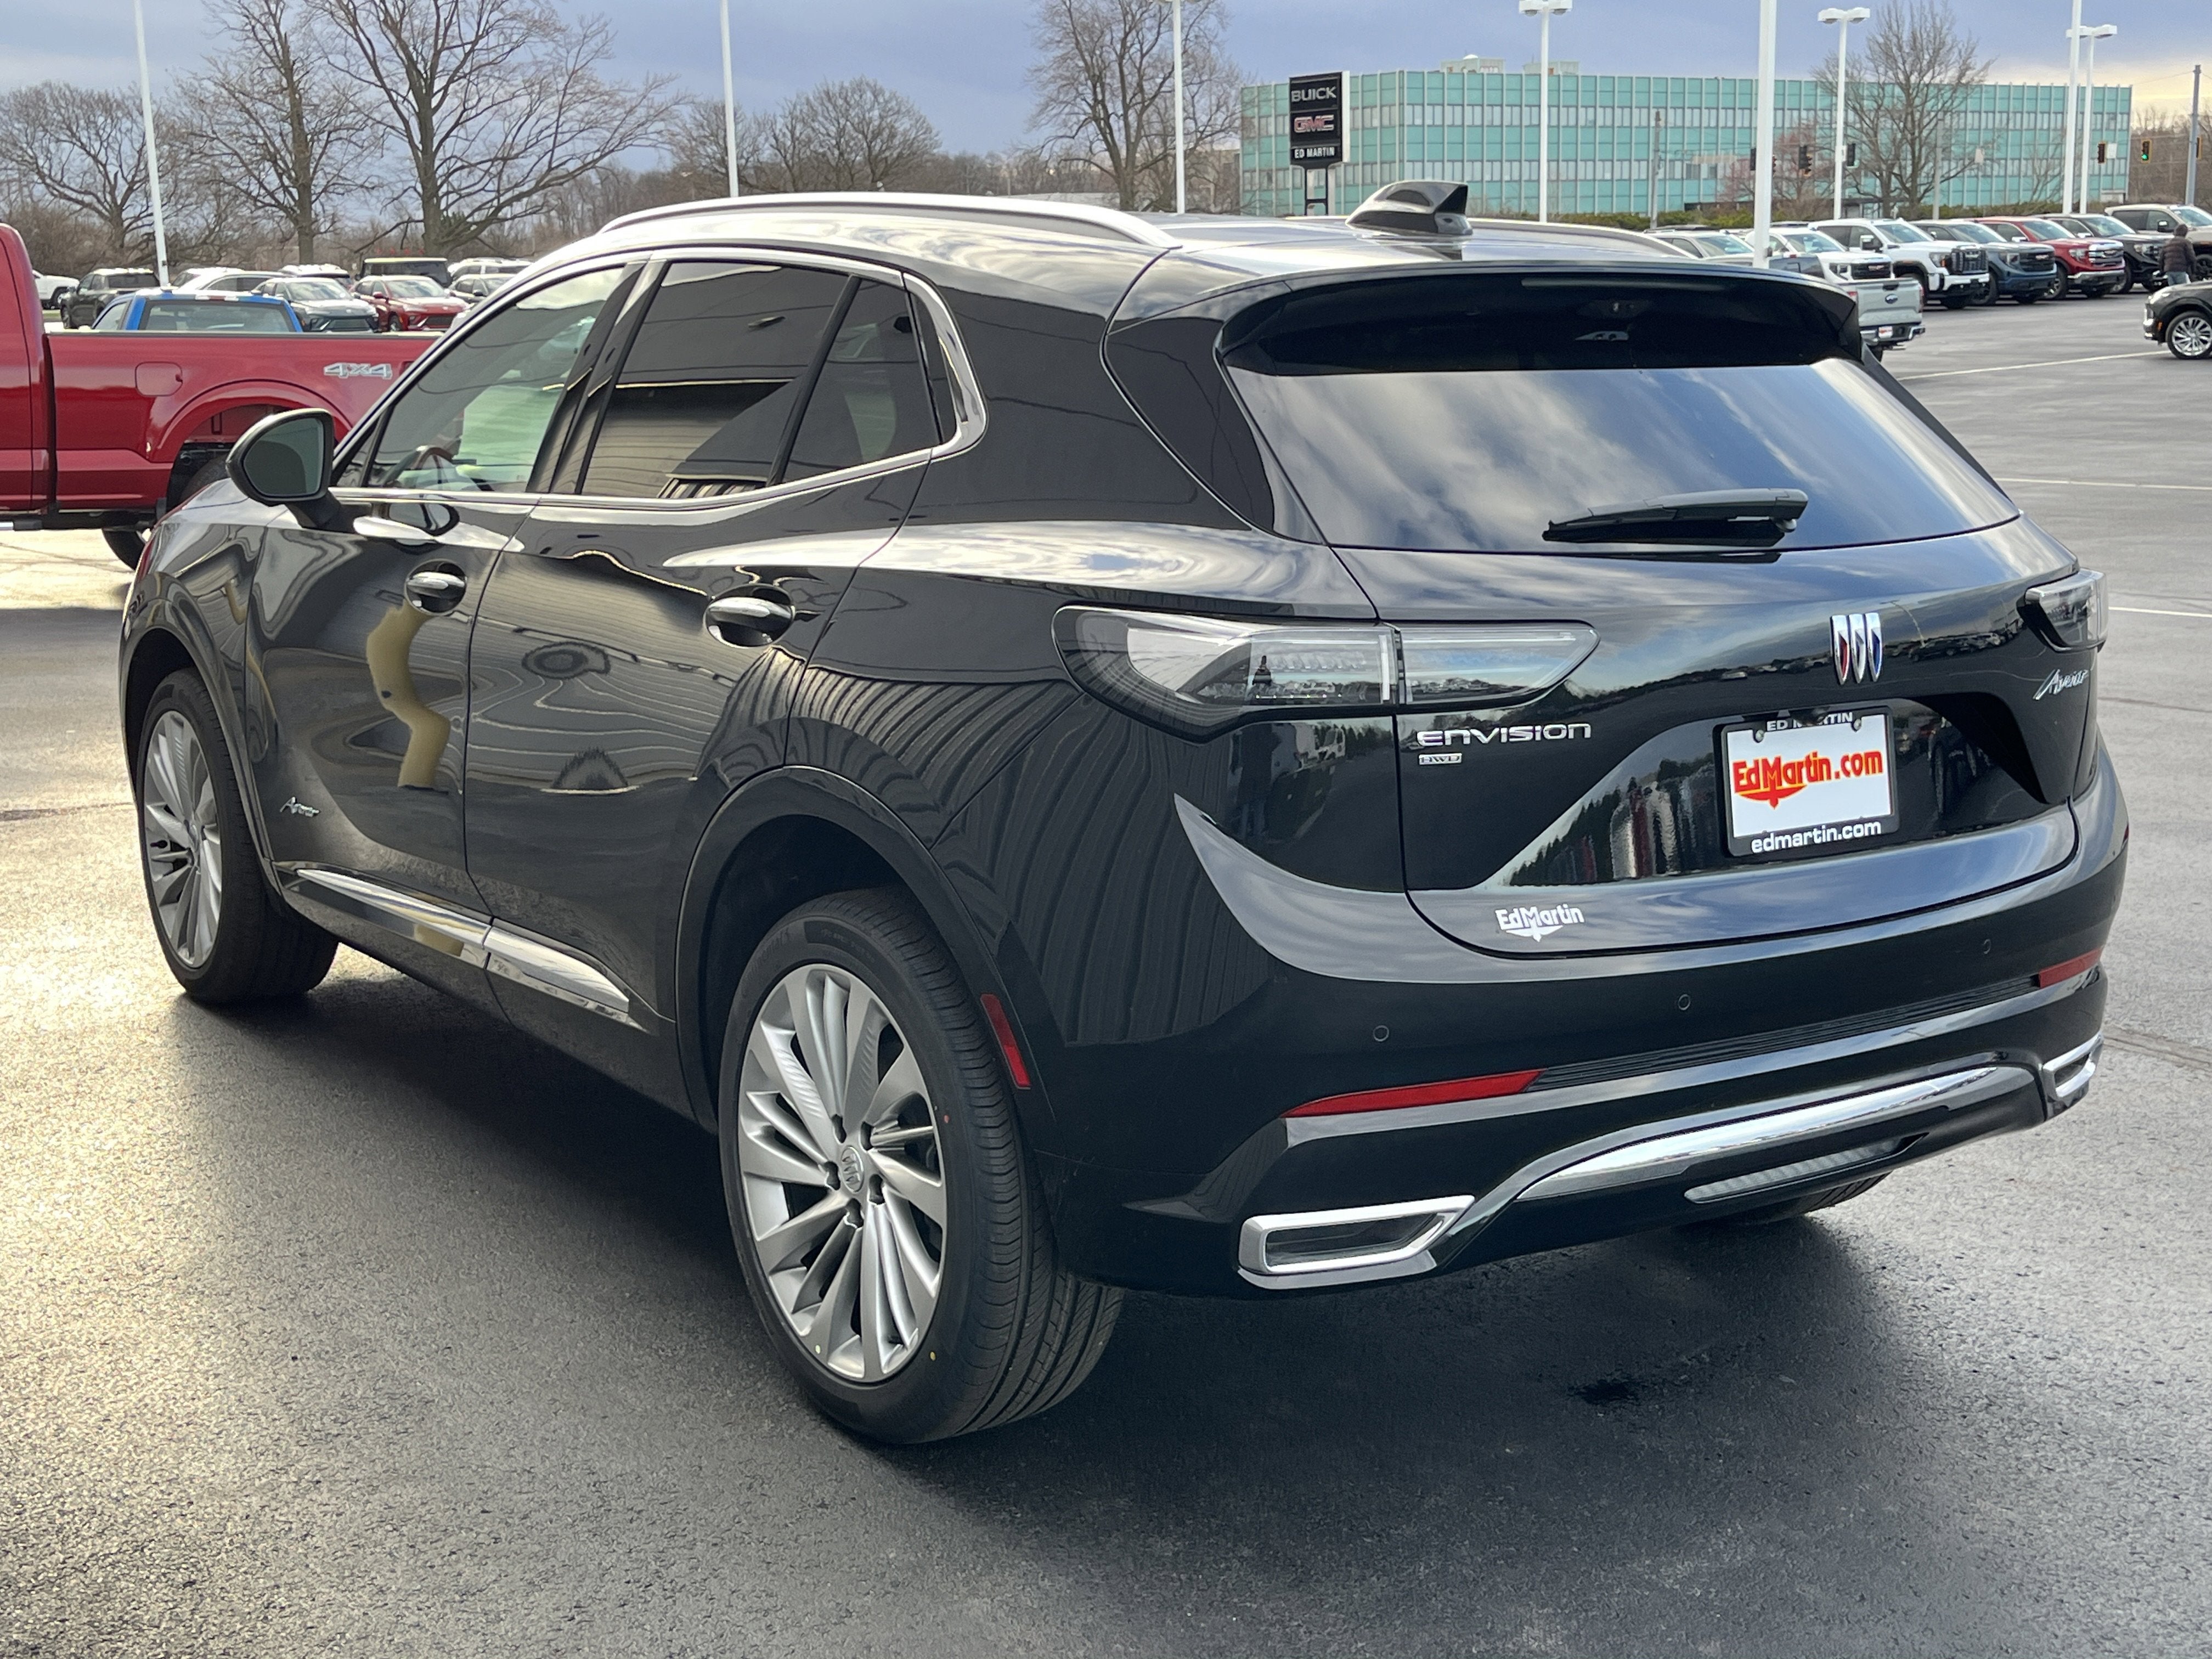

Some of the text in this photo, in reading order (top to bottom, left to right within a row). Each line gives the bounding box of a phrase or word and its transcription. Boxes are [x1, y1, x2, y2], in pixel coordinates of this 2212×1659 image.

[1291, 86, 1337, 102] BUICK
[1294, 114, 1334, 133] GMC
[1294, 146, 1335, 159] ED MARTIN
[1767, 719, 1788, 731] ED
[1733, 751, 1883, 793] EdMartin.com
[1751, 821, 1882, 853] edmartin.com
[1495, 904, 1584, 930] EdMartin
